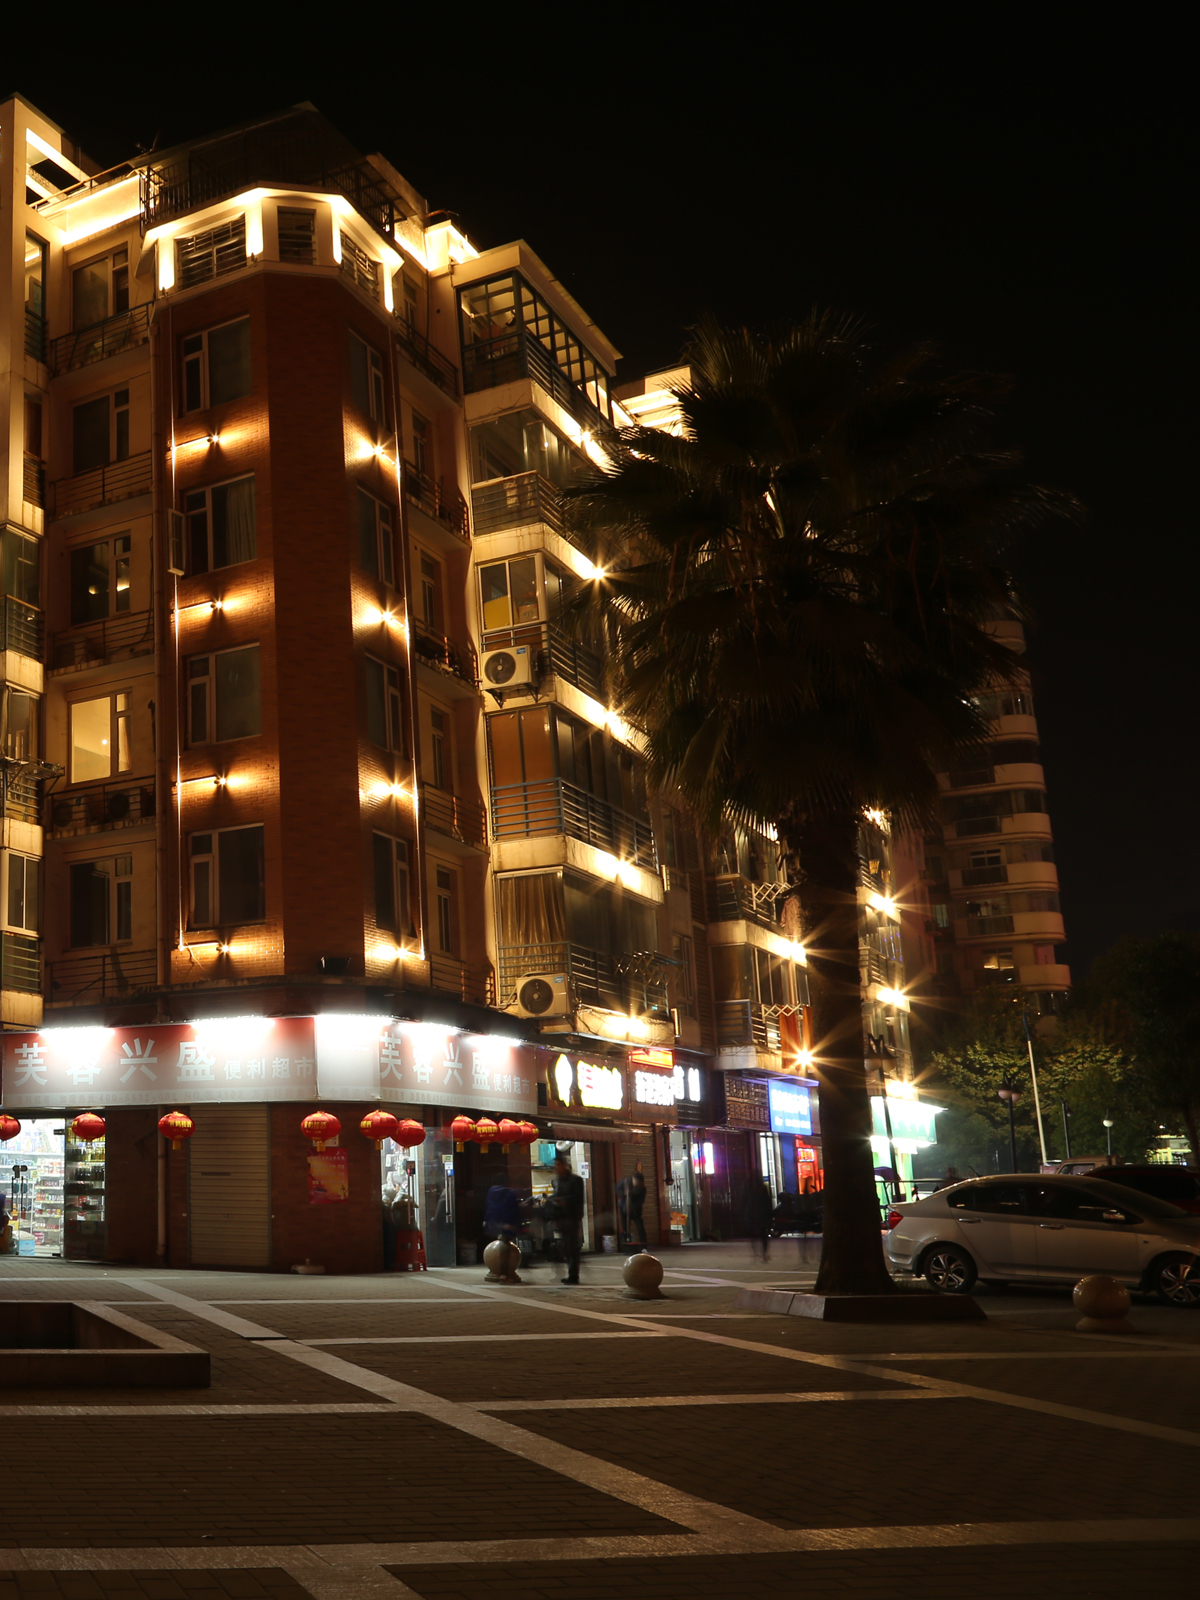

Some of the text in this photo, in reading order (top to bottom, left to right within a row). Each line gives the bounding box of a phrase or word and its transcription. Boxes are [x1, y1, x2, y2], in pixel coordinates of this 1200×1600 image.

[13, 1036, 314, 1086] 芙蓉兴盛 便利超市
[378, 1031, 491, 1091] 芙蓉兴盛
[493, 1073, 530, 1095] 便利超市
